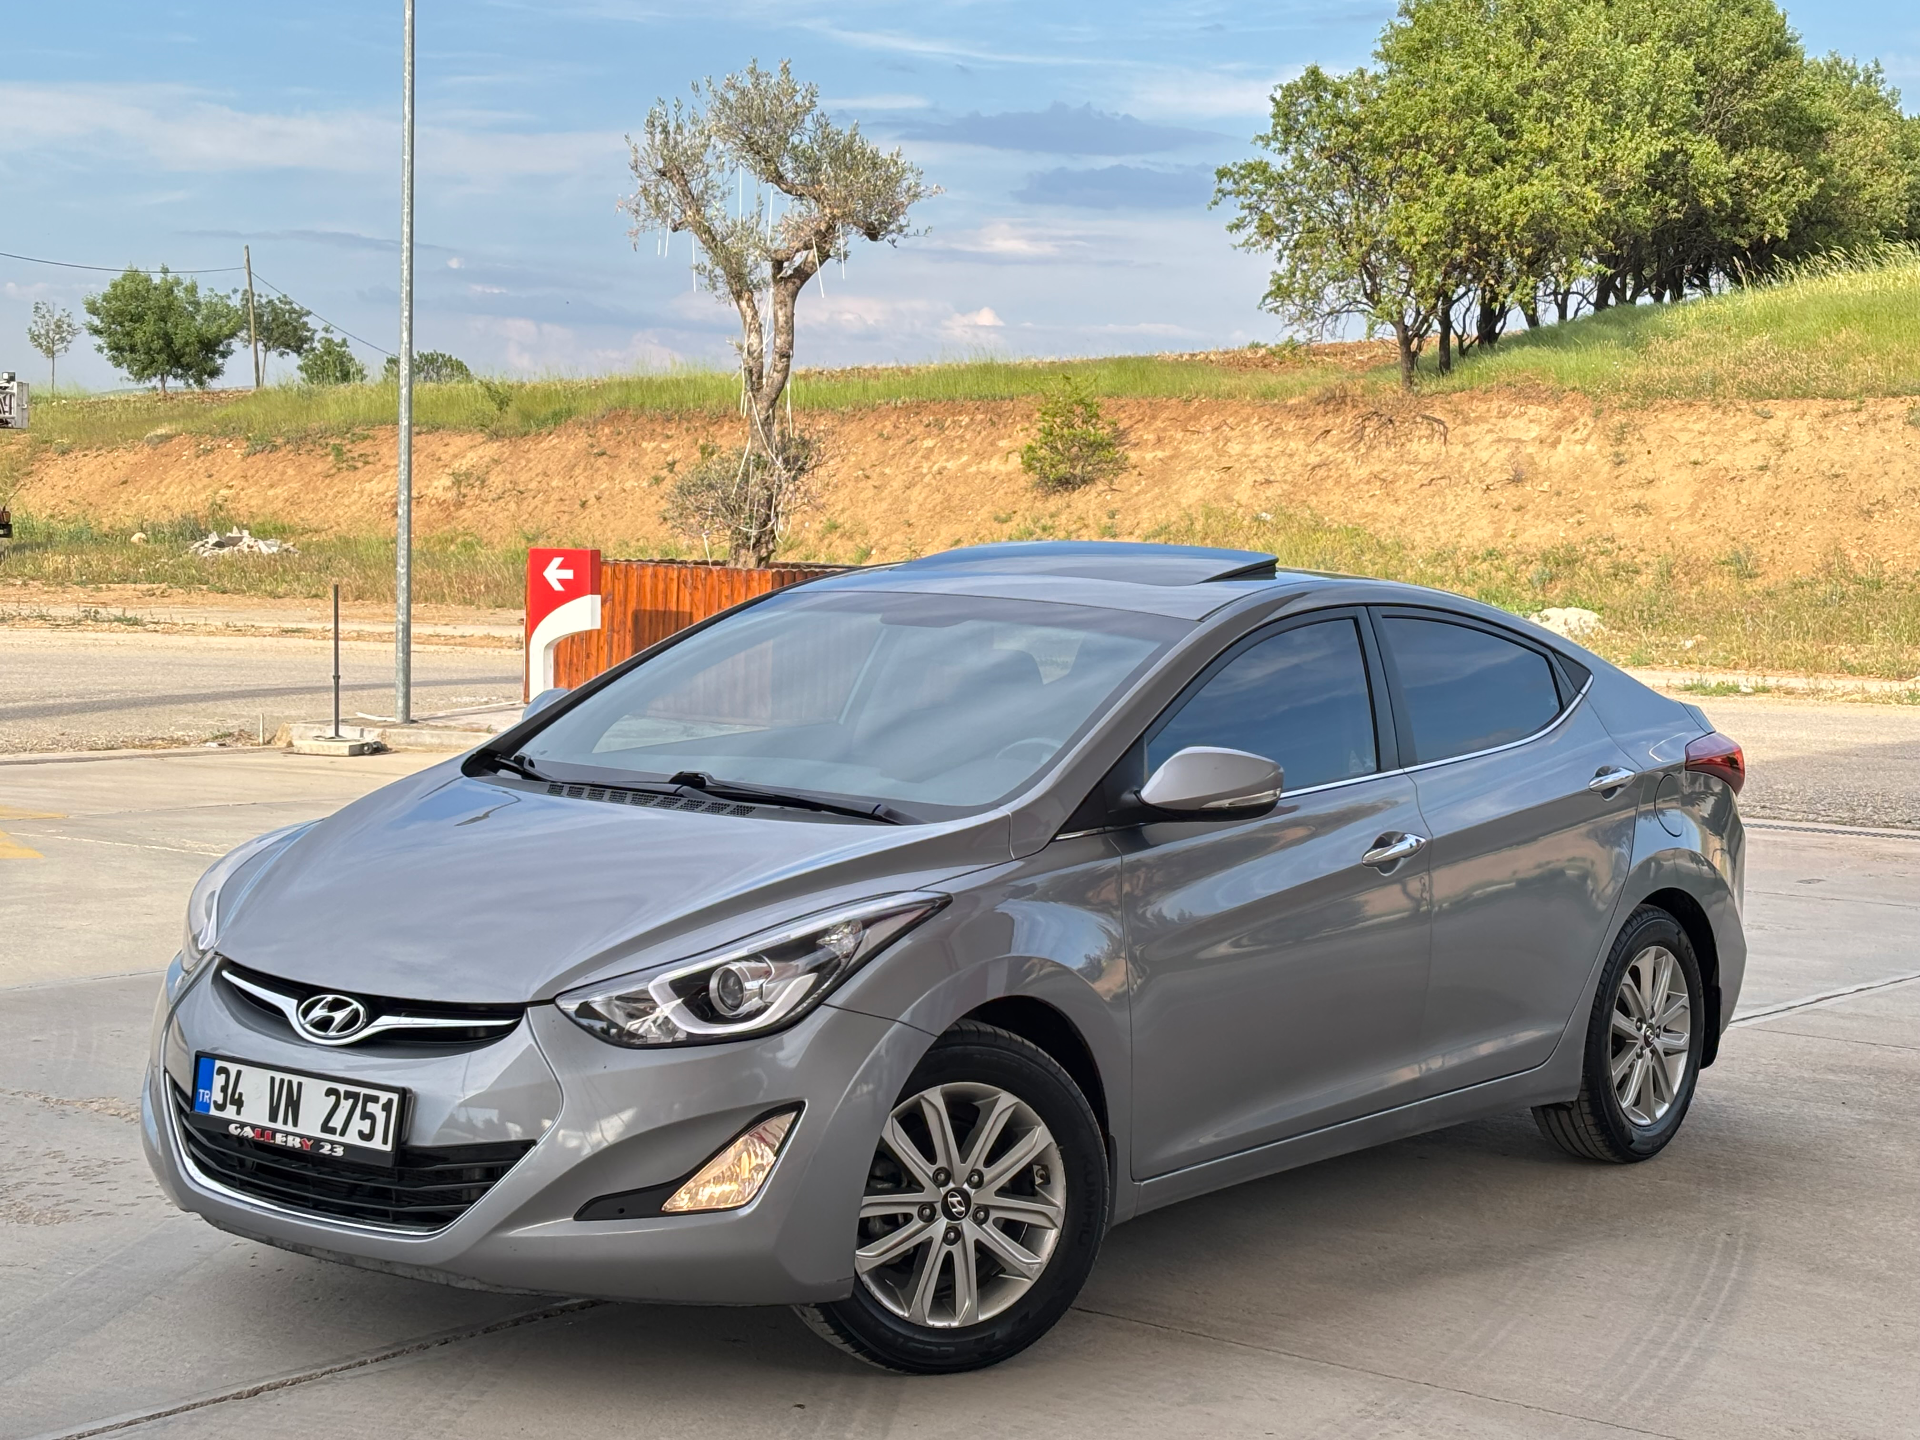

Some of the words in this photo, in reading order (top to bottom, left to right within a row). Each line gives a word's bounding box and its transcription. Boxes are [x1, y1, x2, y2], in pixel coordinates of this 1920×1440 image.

[198, 1088, 211, 1104] TR
[212, 1065, 244, 1116] 34
[268, 1075, 303, 1128] VN
[320, 1086, 394, 1146] 2751
[228, 1123, 314, 1151] GALLERY
[318, 1141, 345, 1157] 23
